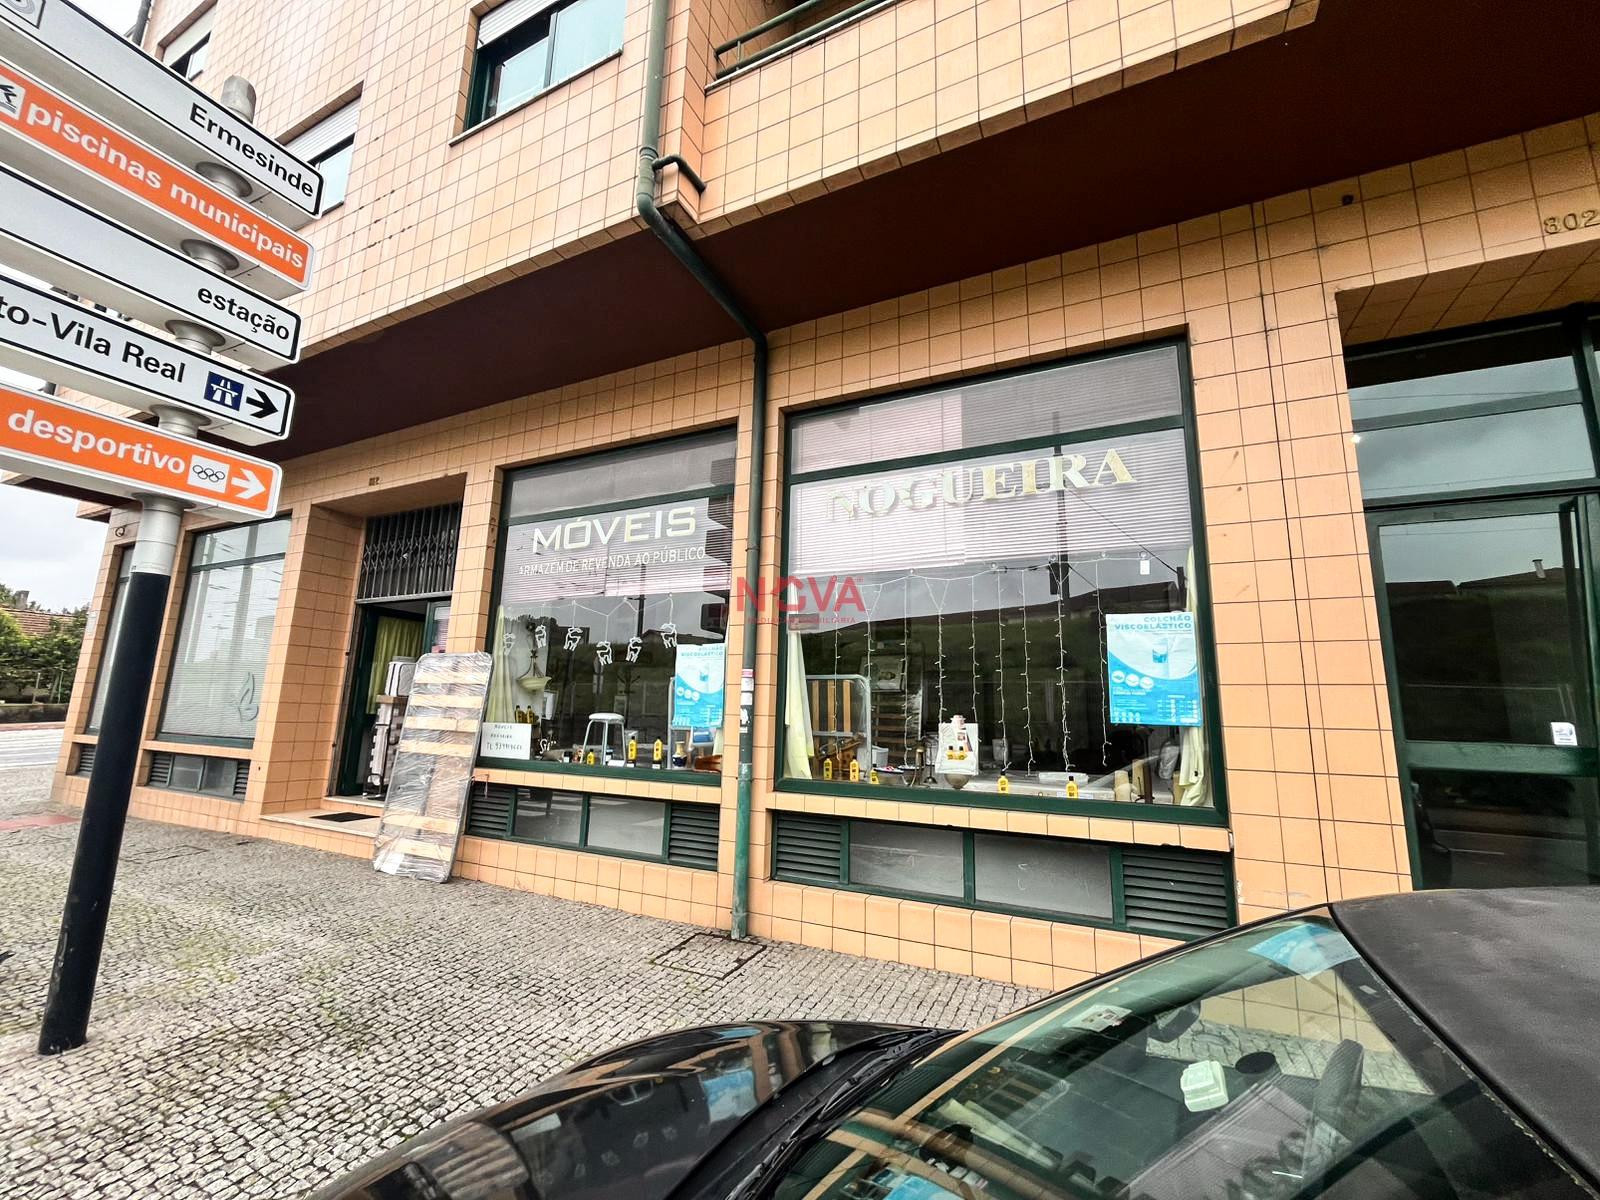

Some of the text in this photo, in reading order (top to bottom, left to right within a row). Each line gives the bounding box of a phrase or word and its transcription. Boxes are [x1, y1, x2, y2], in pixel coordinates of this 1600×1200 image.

[189, 102, 314, 198] Ermesinde
[26, 102, 304, 269] piscinas municipais
[1543, 209, 1599, 235] 802
[197, 287, 290, 341] estação
[121, 340, 186, 384] Real
[7, 409, 186, 475] desportivo
[825, 447, 1137, 523] NOGUEIRA
[532, 506, 697, 553] MÓVEIS
[566, 559, 580, 573] DE
[634, 553, 650, 567] AO
[652, 546, 706, 564] PÚBLICO
